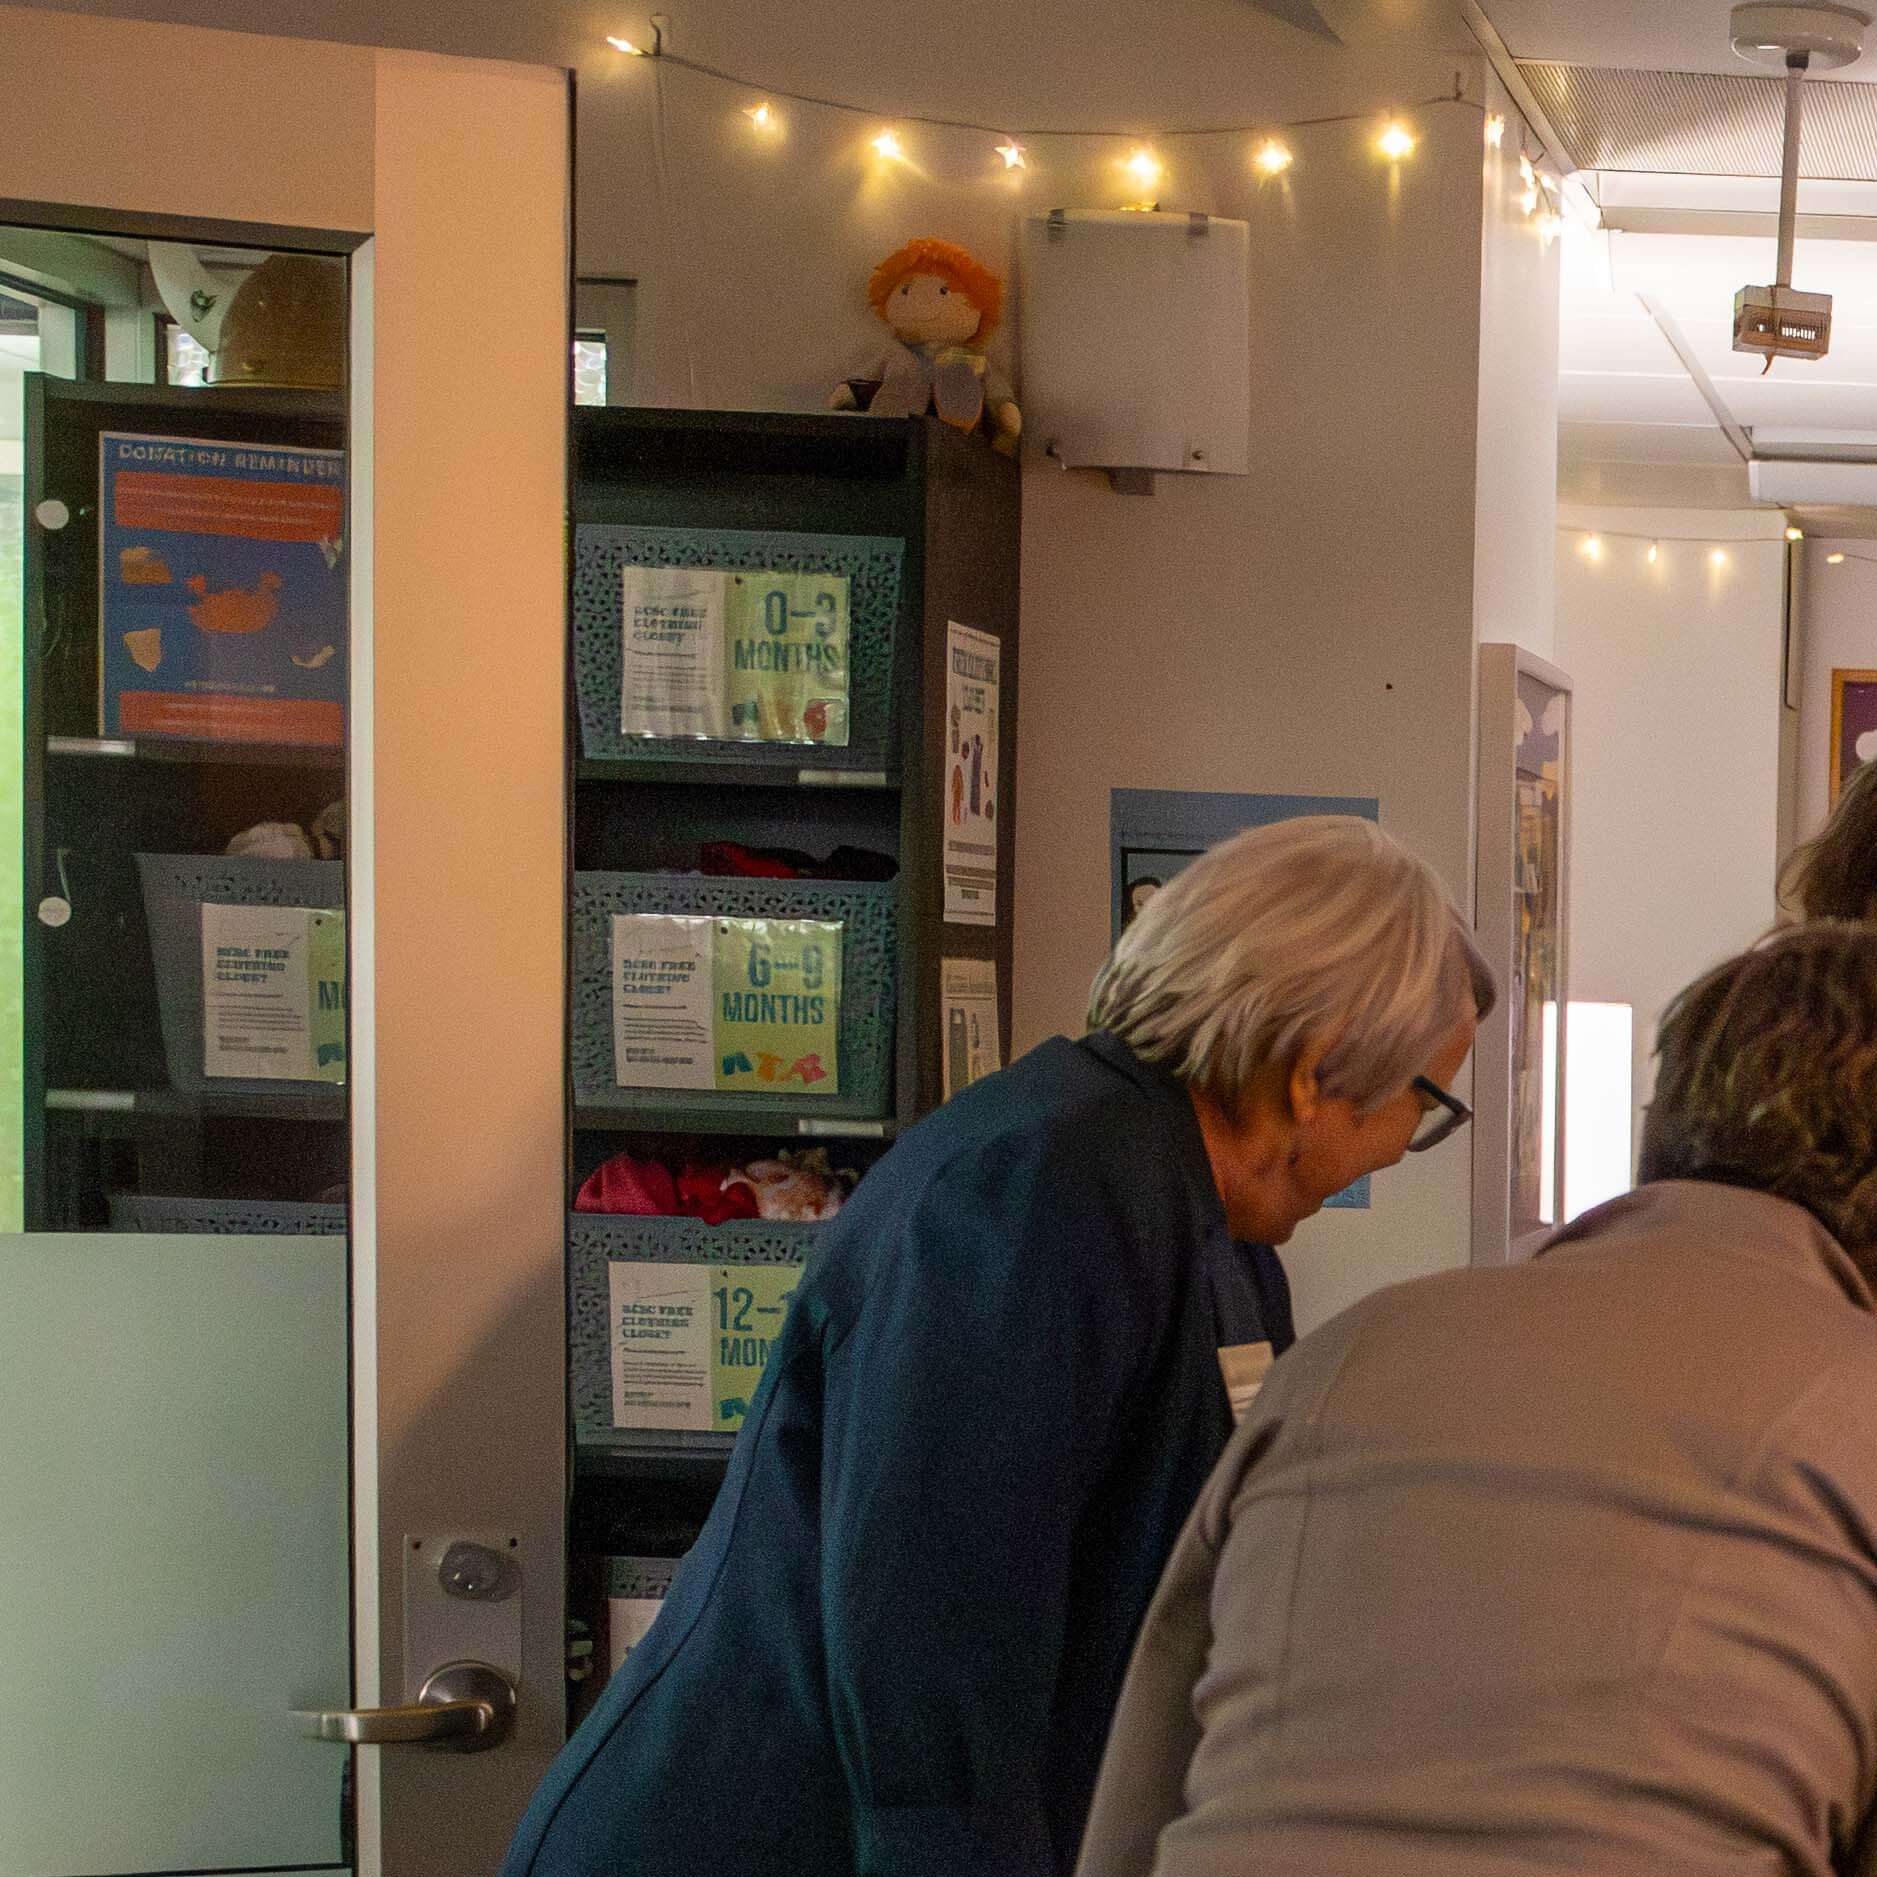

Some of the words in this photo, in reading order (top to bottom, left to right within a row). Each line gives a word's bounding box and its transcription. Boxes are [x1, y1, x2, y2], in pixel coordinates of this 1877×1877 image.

[119, 444, 225, 467] DONATION
[764, 590, 837, 637] 0-3
[734, 639, 840, 674] MONTHS
[749, 941, 824, 990] 6-9
[723, 992, 825, 1025] MONTHS
